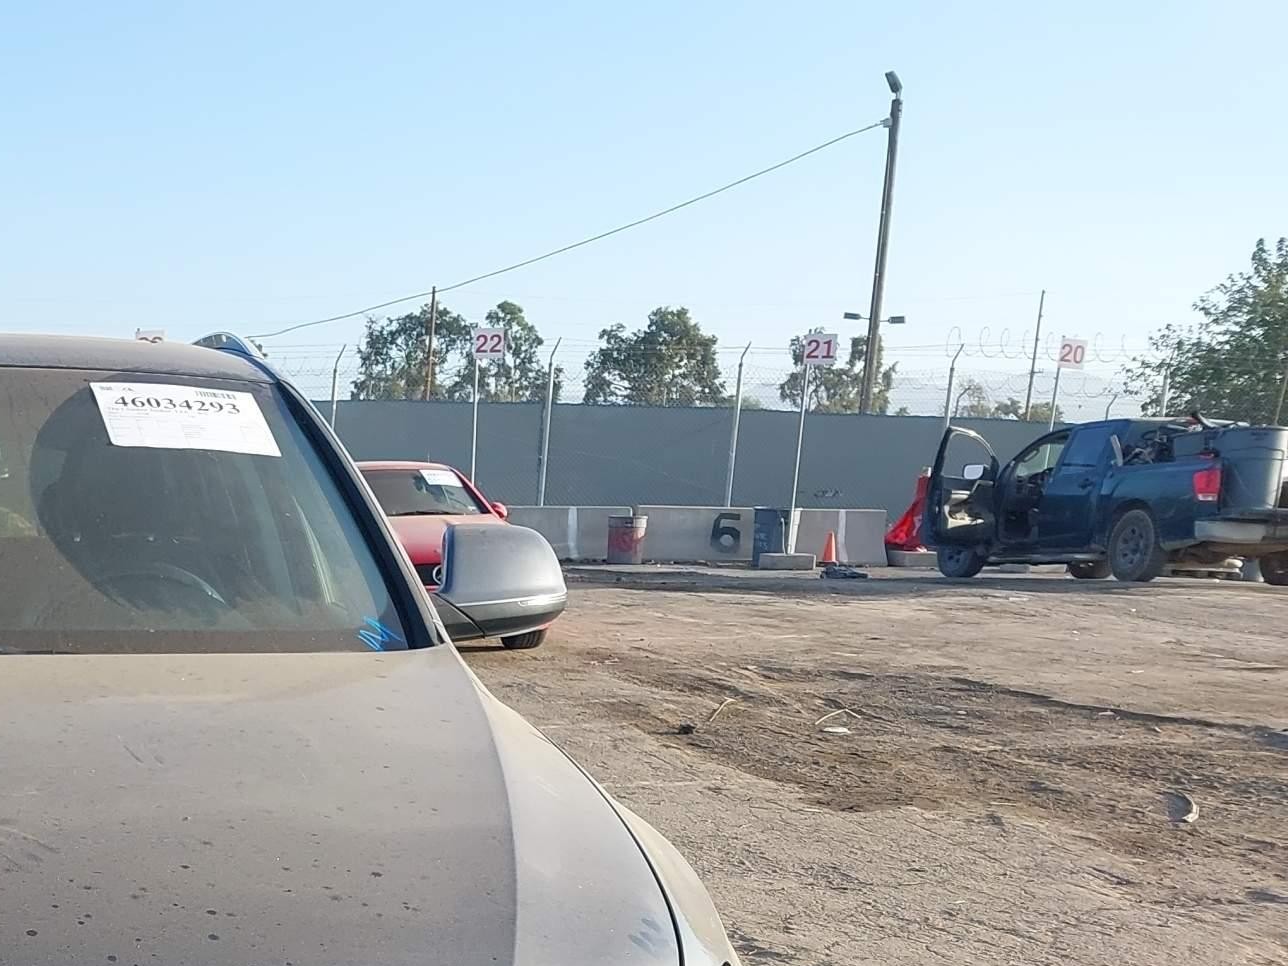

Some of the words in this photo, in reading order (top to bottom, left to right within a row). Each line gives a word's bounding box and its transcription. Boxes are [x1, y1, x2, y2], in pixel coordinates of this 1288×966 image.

[475, 334, 502, 354] 22
[805, 339, 834, 359] 21
[1060, 343, 1085, 364] 20
[114, 395, 241, 415] 46034293
[711, 512, 740, 554] 6
